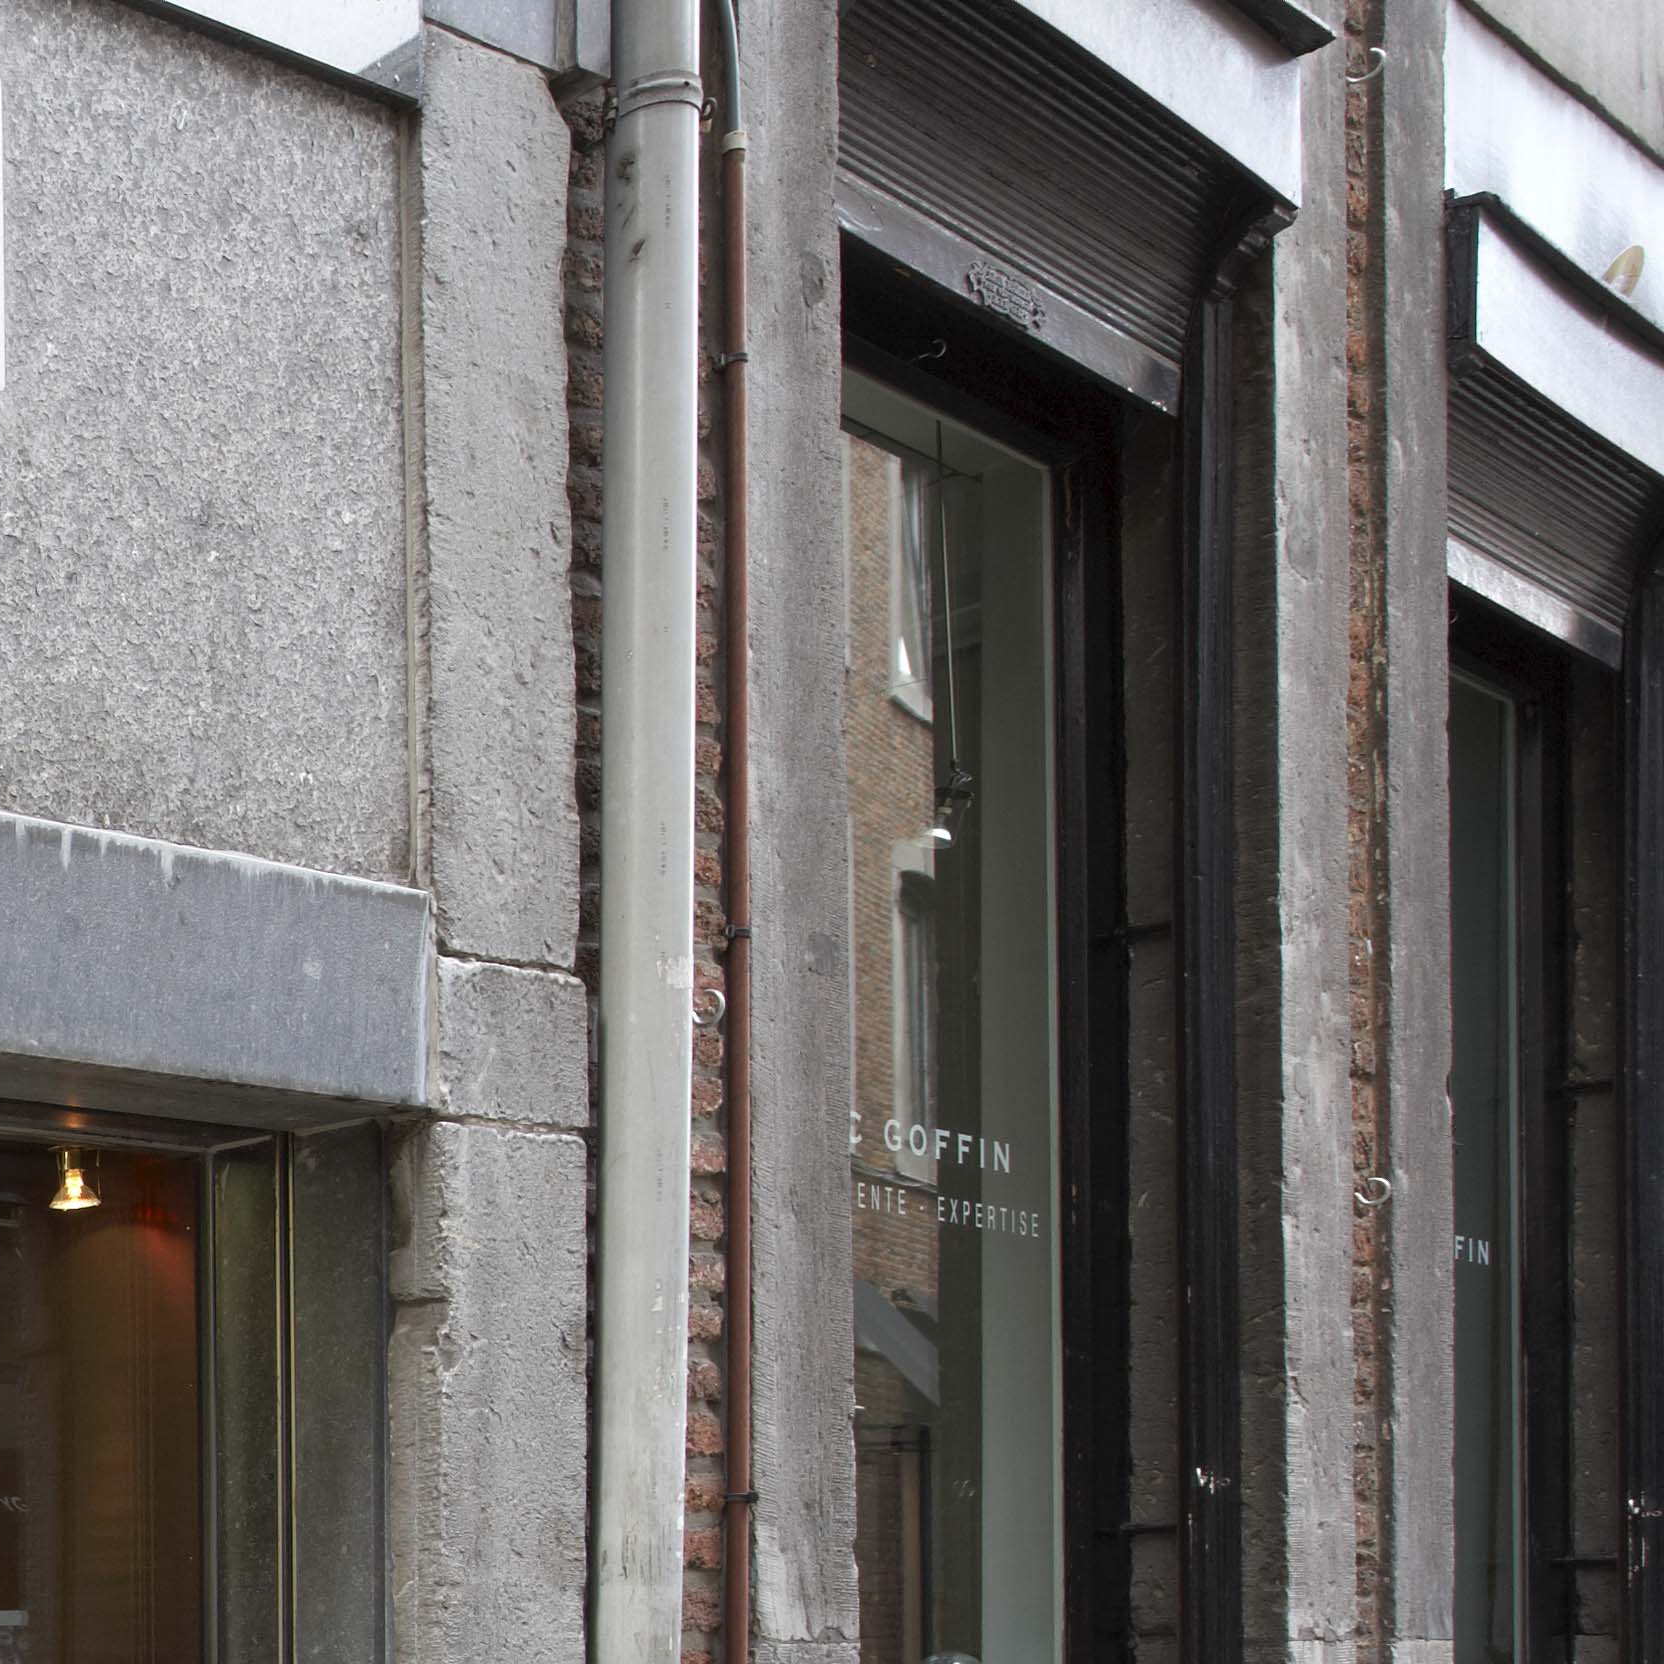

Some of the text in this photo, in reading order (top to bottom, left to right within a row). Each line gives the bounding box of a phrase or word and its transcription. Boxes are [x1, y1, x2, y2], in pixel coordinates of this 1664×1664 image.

[884, 1118, 1010, 1173] GOFFIN
[857, 1182, 907, 1215] ENTE
[937, 1196, 1040, 1238] EXPERTISE
[1455, 1235, 1489, 1265] FIN
